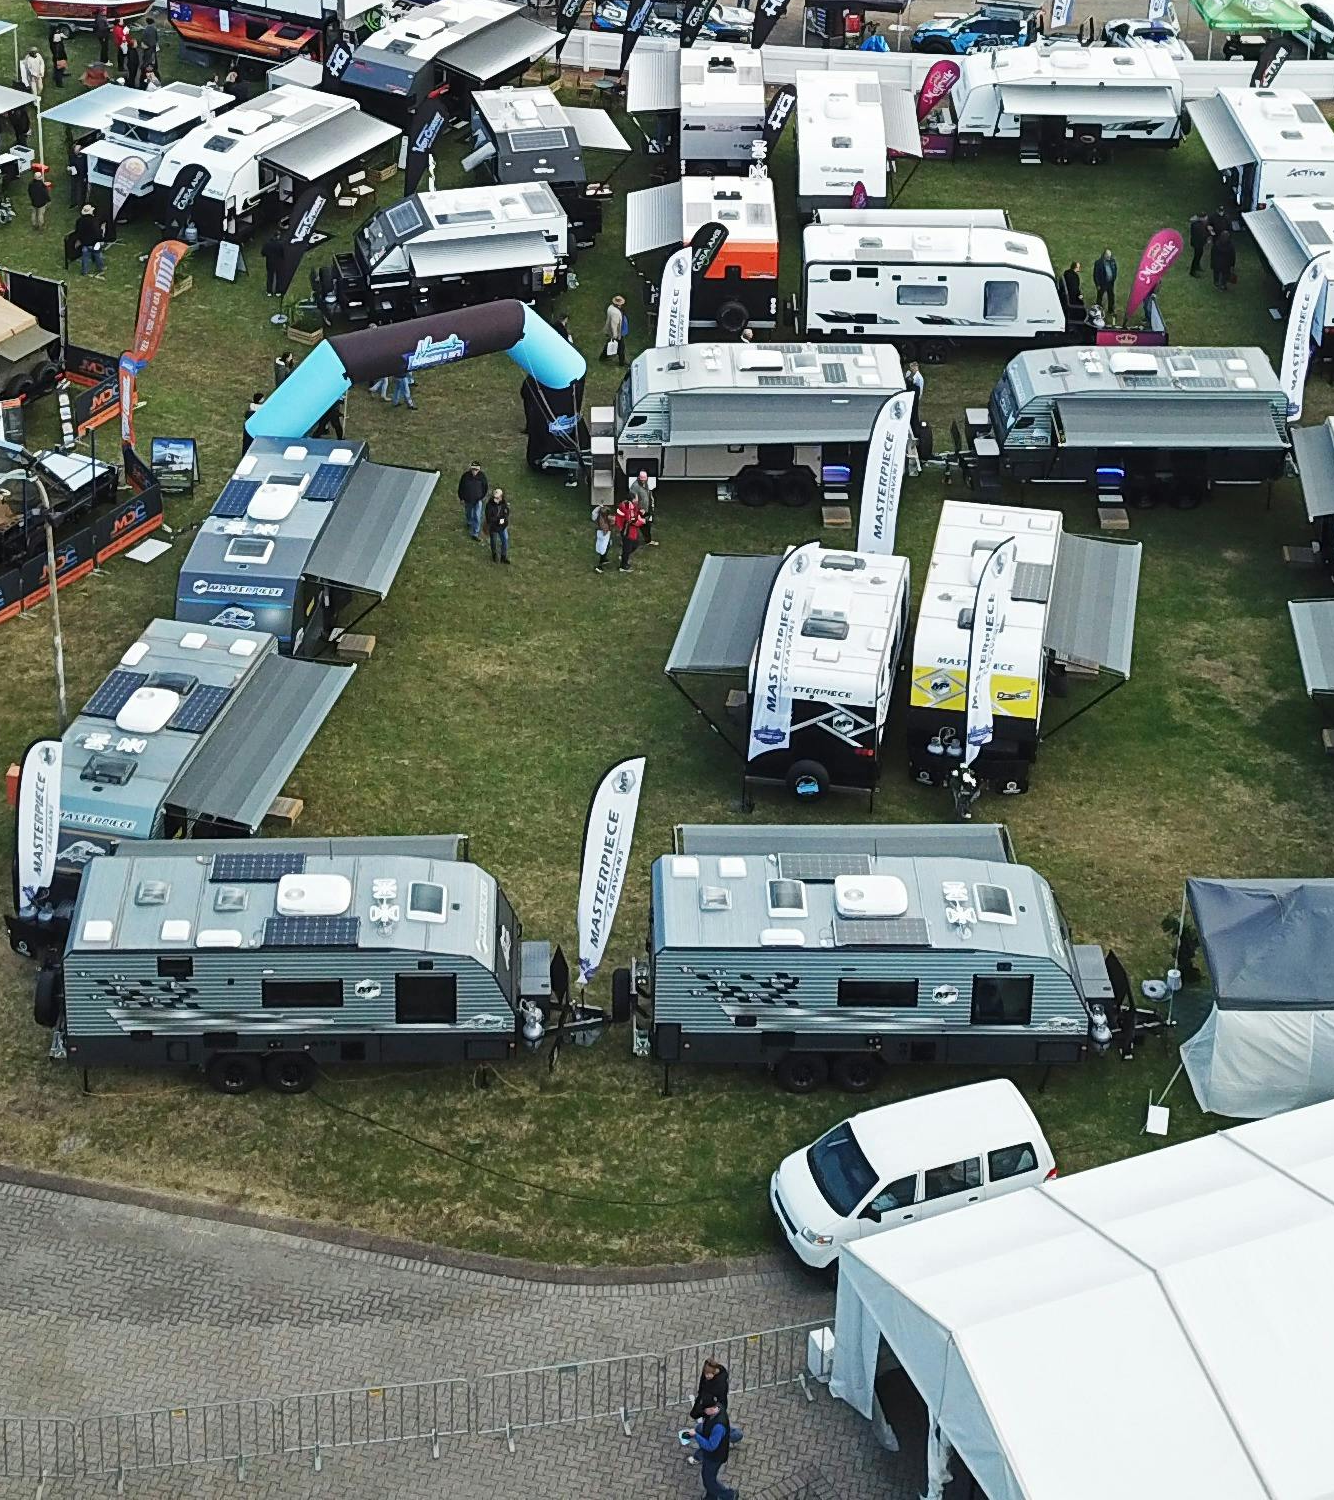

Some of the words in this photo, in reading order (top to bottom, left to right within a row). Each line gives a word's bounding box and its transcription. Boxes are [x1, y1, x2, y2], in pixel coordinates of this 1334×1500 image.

[330, 47, 350, 78] HQ
[768, 91, 796, 132] HQ
[1289, 292, 1312, 393] MASTERPIECE
[113, 500, 147, 536] MDC
[872, 430, 896, 541] MASTERPIECE
[765, 587, 795, 713] MASTERPIECE
[970, 592, 997, 710] MASTERPIECE
[31, 771, 48, 877] MASTERPIECE
[589, 809, 620, 950] MASTERPIECE
